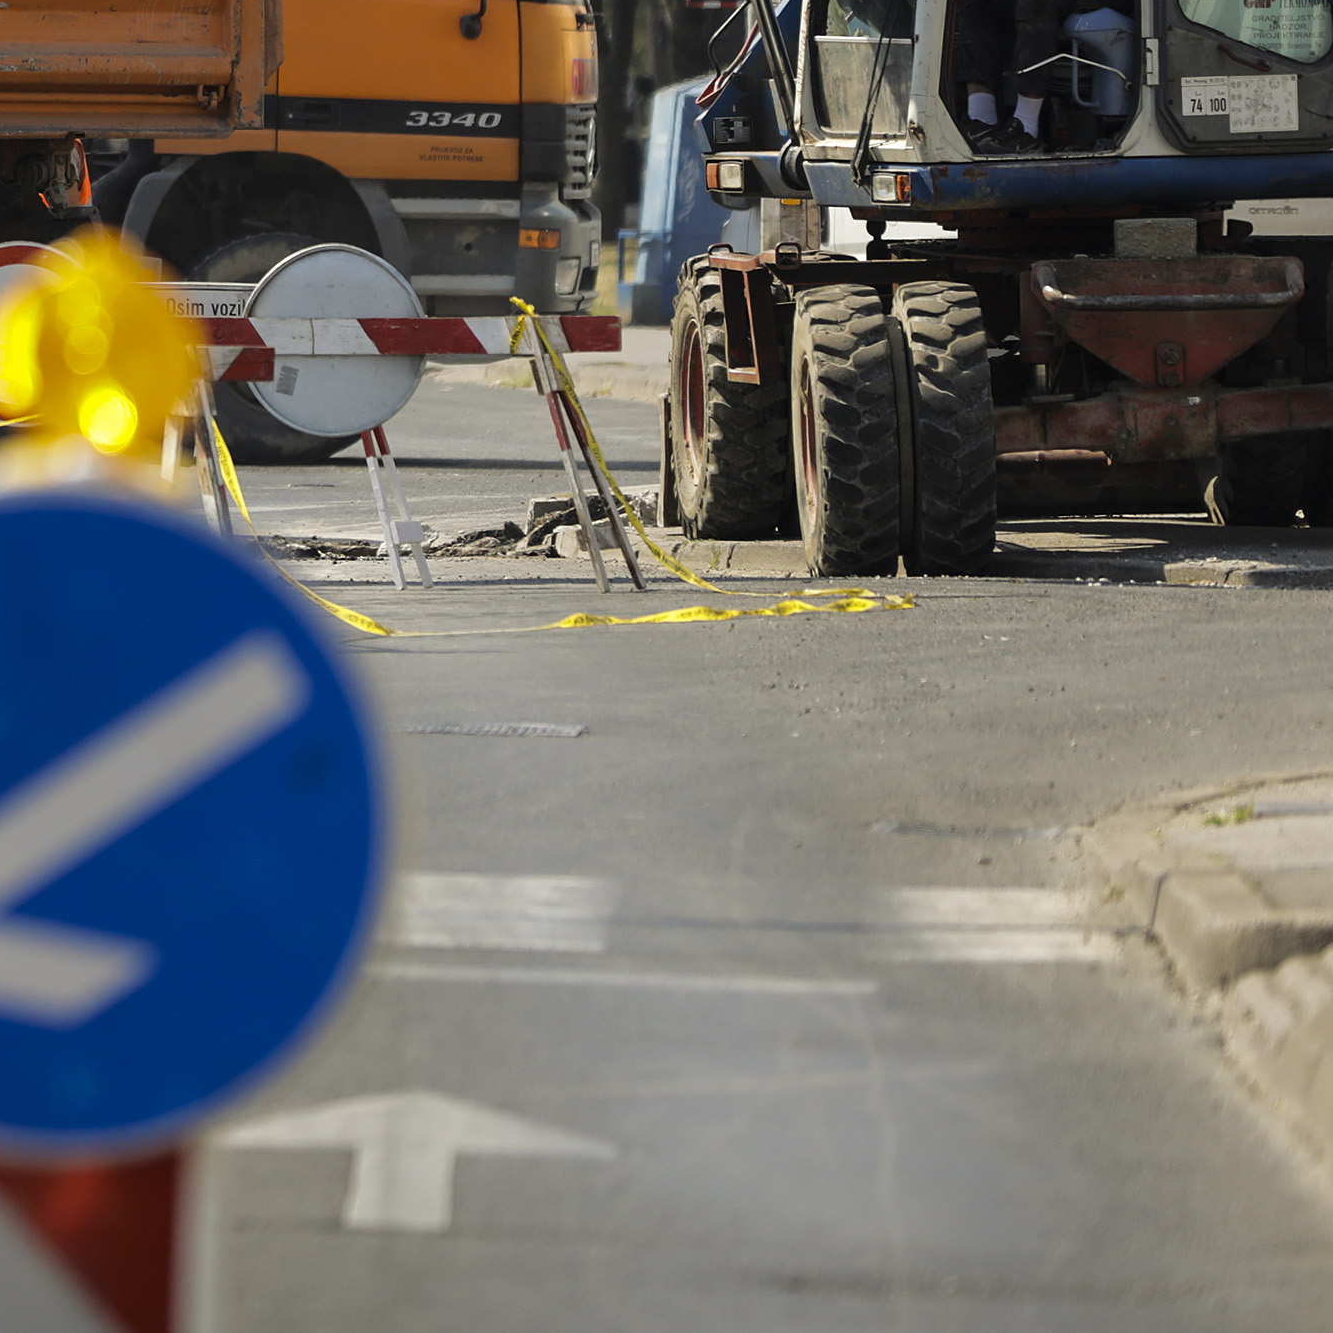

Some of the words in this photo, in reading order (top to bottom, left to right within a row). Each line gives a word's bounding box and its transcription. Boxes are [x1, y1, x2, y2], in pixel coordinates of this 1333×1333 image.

[1190, 98, 1203, 113] 74
[1209, 97, 1227, 112] 100
[406, 111, 502, 128] 3340
[166, 298, 205, 316] Osim
